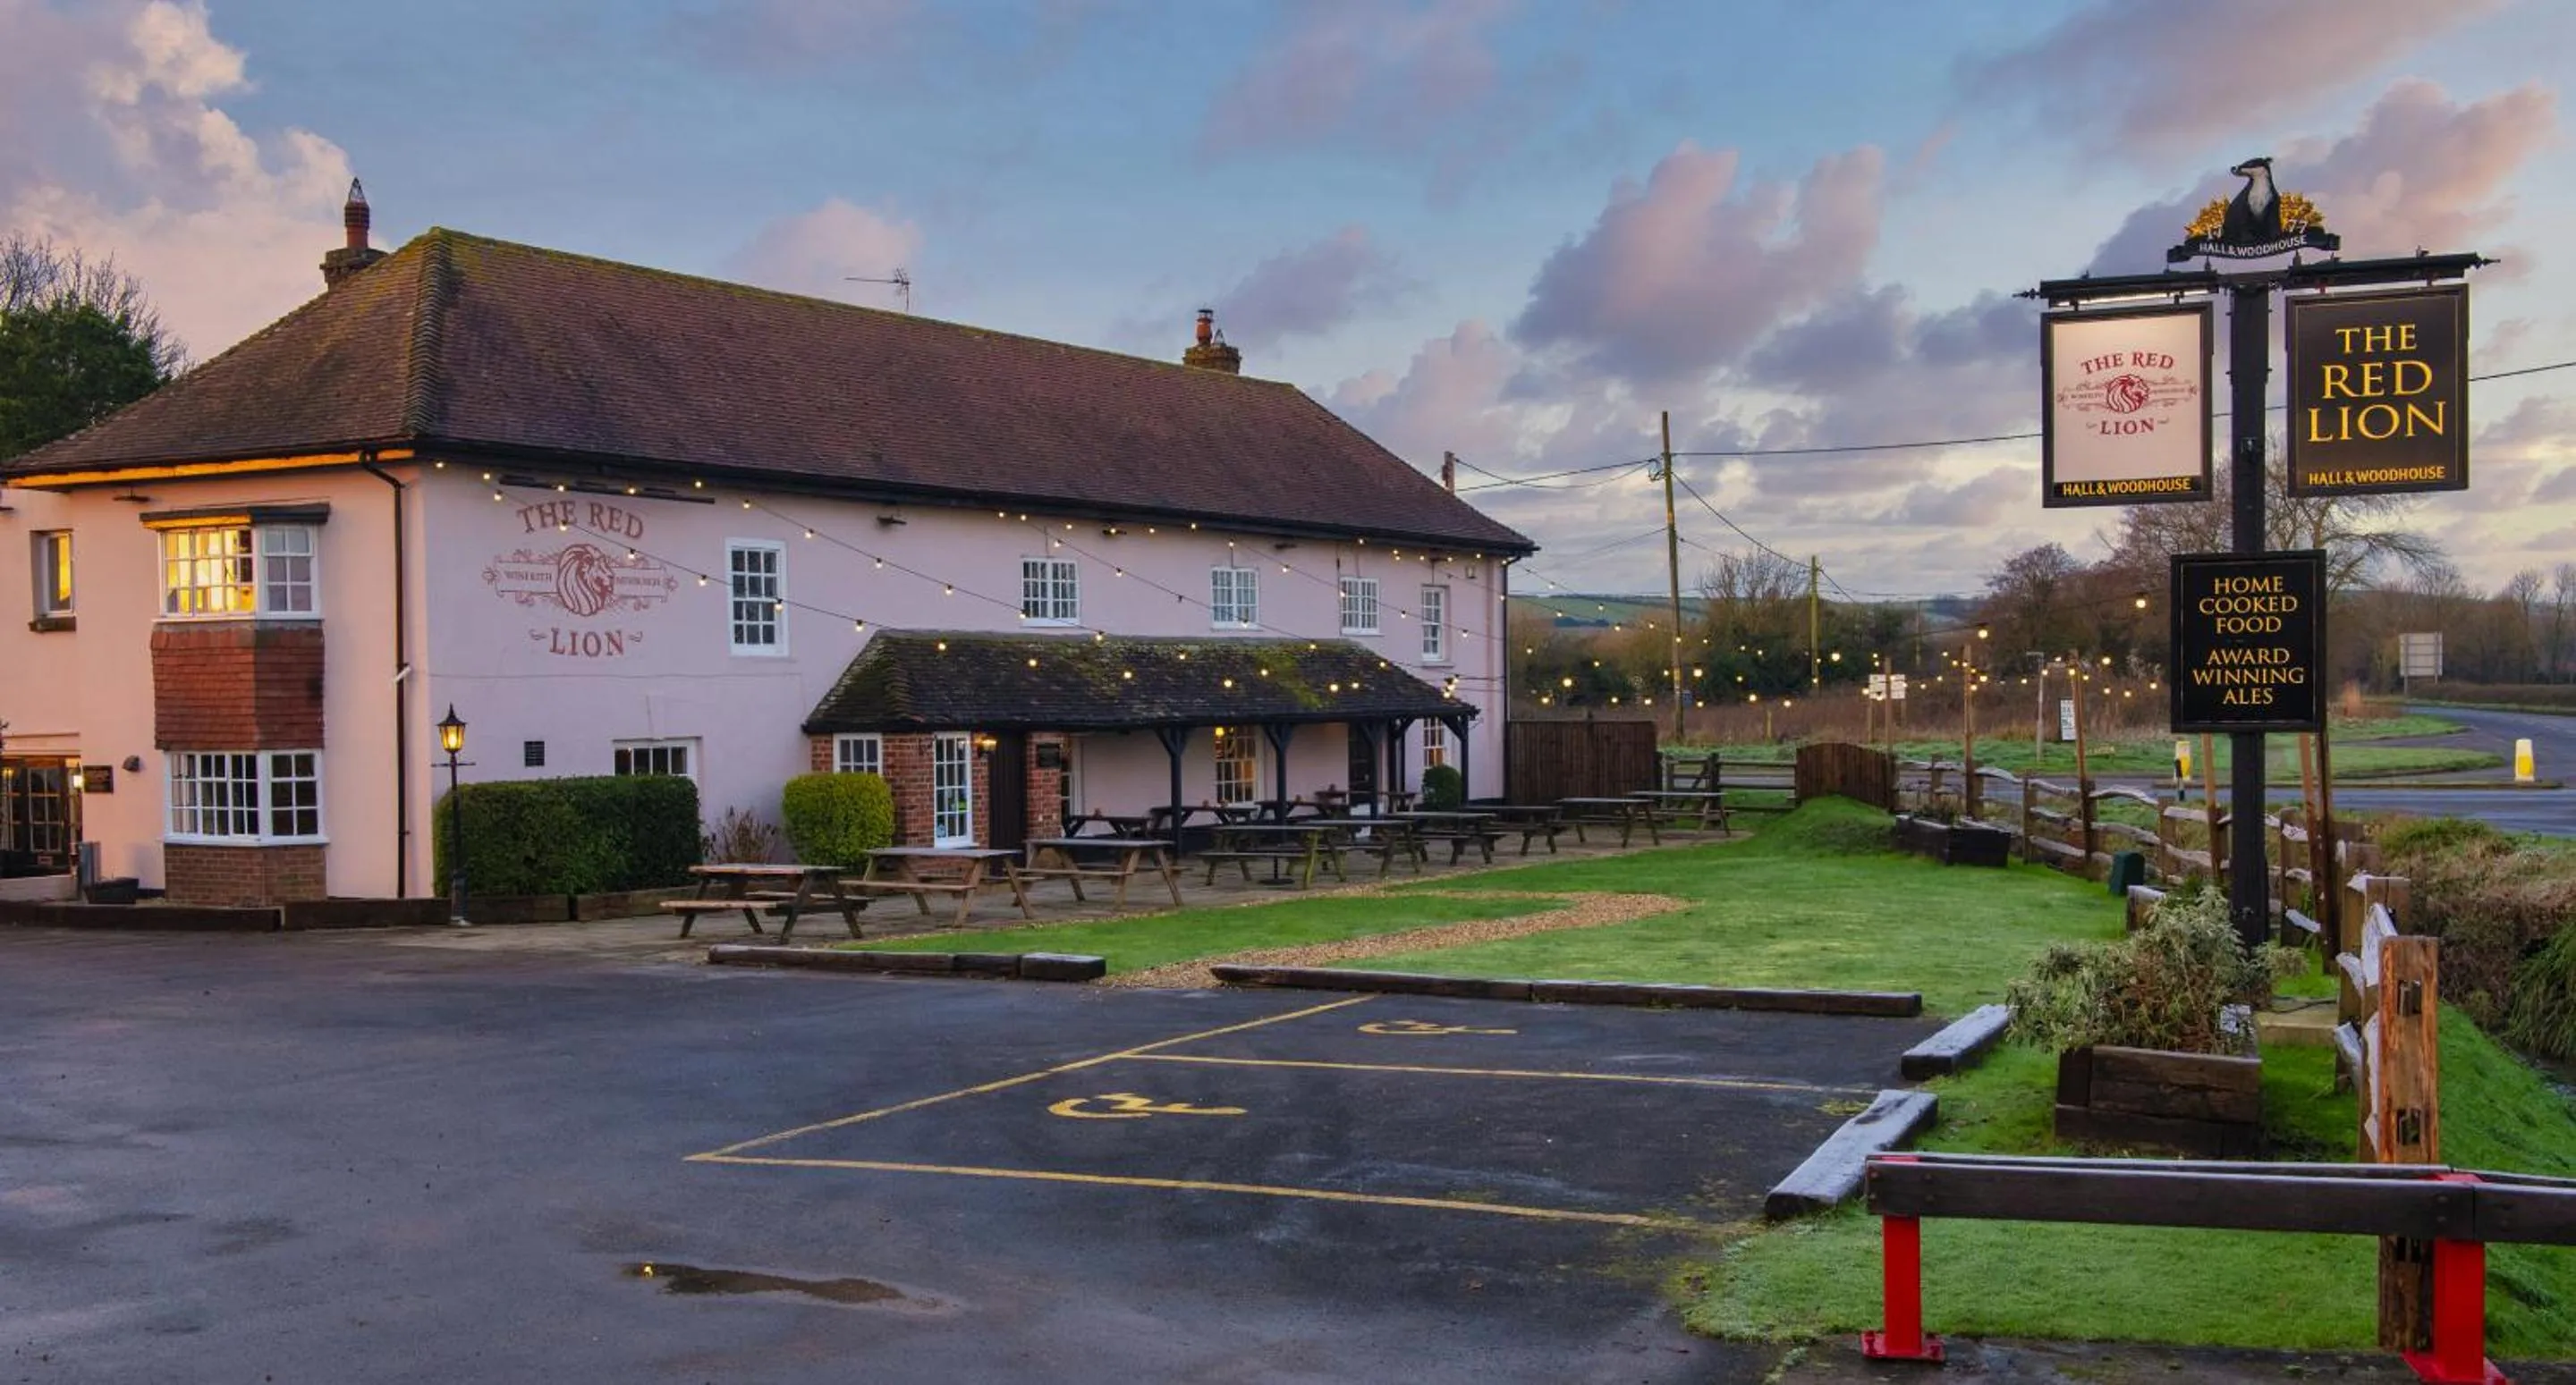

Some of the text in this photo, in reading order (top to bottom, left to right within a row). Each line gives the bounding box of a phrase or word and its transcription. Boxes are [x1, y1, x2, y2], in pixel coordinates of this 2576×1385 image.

[2334, 324, 2418, 354] THE
[2080, 352, 2174, 375] THE RED
[2322, 359, 2433, 399] RED
[2100, 418, 2155, 435] LION
[2308, 401, 2446, 442] LION
[517, 501, 644, 539] THE RED
[2214, 576, 2284, 595] HOME
[2199, 595, 2299, 615] COOKED
[2216, 616, 2282, 634] FOOD
[549, 627, 624, 657] LION
[2206, 647, 2291, 665] AWARD
[2192, 667, 2305, 686] WINNING
[2223, 688, 2274, 705] ALES
